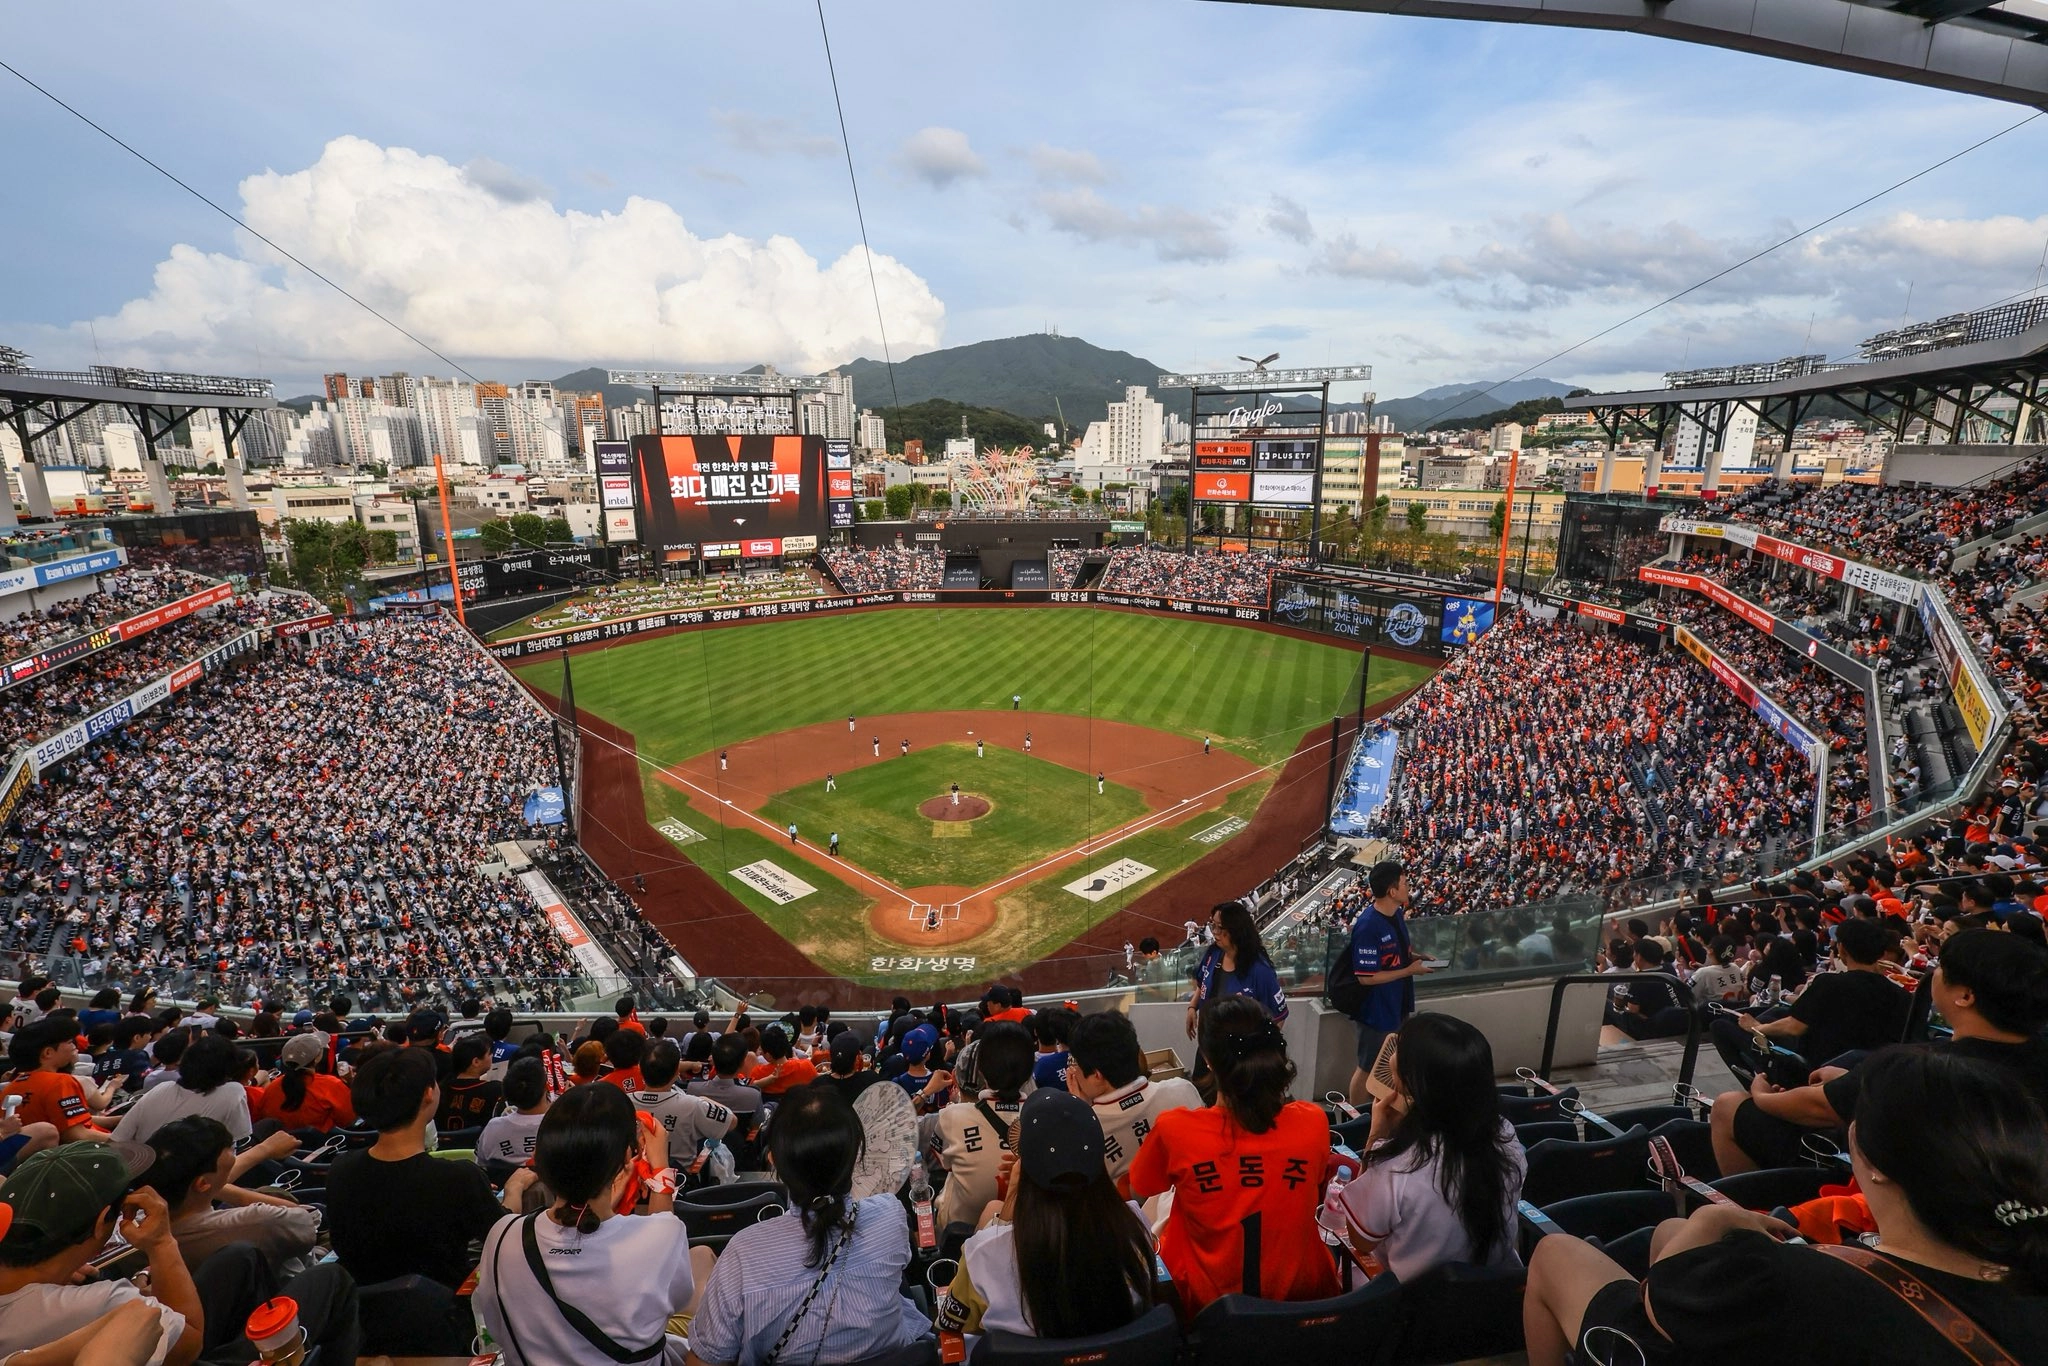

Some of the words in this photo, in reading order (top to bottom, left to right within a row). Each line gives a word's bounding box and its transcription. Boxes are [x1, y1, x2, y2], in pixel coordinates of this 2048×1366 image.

[666, 404, 694, 419] 대전
[697, 404, 747, 419] 한화생명
[753, 404, 789, 419] 볼파크
[1228, 400, 1283, 427] Eagles
[692, 463, 711, 472] 대전
[711, 462, 748, 472] 한화생명
[751, 461, 778, 471] 볼파크
[670, 475, 708, 498] 최다
[711, 474, 747, 497] 매진
[751, 473, 800, 496] 신기록
[608, 495, 629, 505] intel
[464, 577, 486, 591] GS25
[1051, 592, 1089, 602] 대방건설
[780, 601, 810, 614] 로제비앙
[1236, 609, 1260, 620] DEEPS
[1324, 608, 1351, 623] HOME
[1352, 612, 1373, 626] RUN
[1385, 609, 1427, 633] Eagles
[1594, 609, 1621, 622] INNINGS
[1334, 623, 1360, 636] ZONE
[1636, 619, 1659, 629] aramark
[527, 636, 563, 653] 한남대학교
[91, 709, 114, 736] 모두의
[113, 702, 130, 723] 안과
[37, 737, 65, 766] 모두의
[65, 728, 84, 750] 안과
[659, 825, 690, 841] GS25
[1104, 863, 1135, 879] LIFE
[1113, 867, 1143, 883] PLUS
[872, 957, 977, 972] 한화생명
[1070, 1354, 1102, 1363] 11-06
